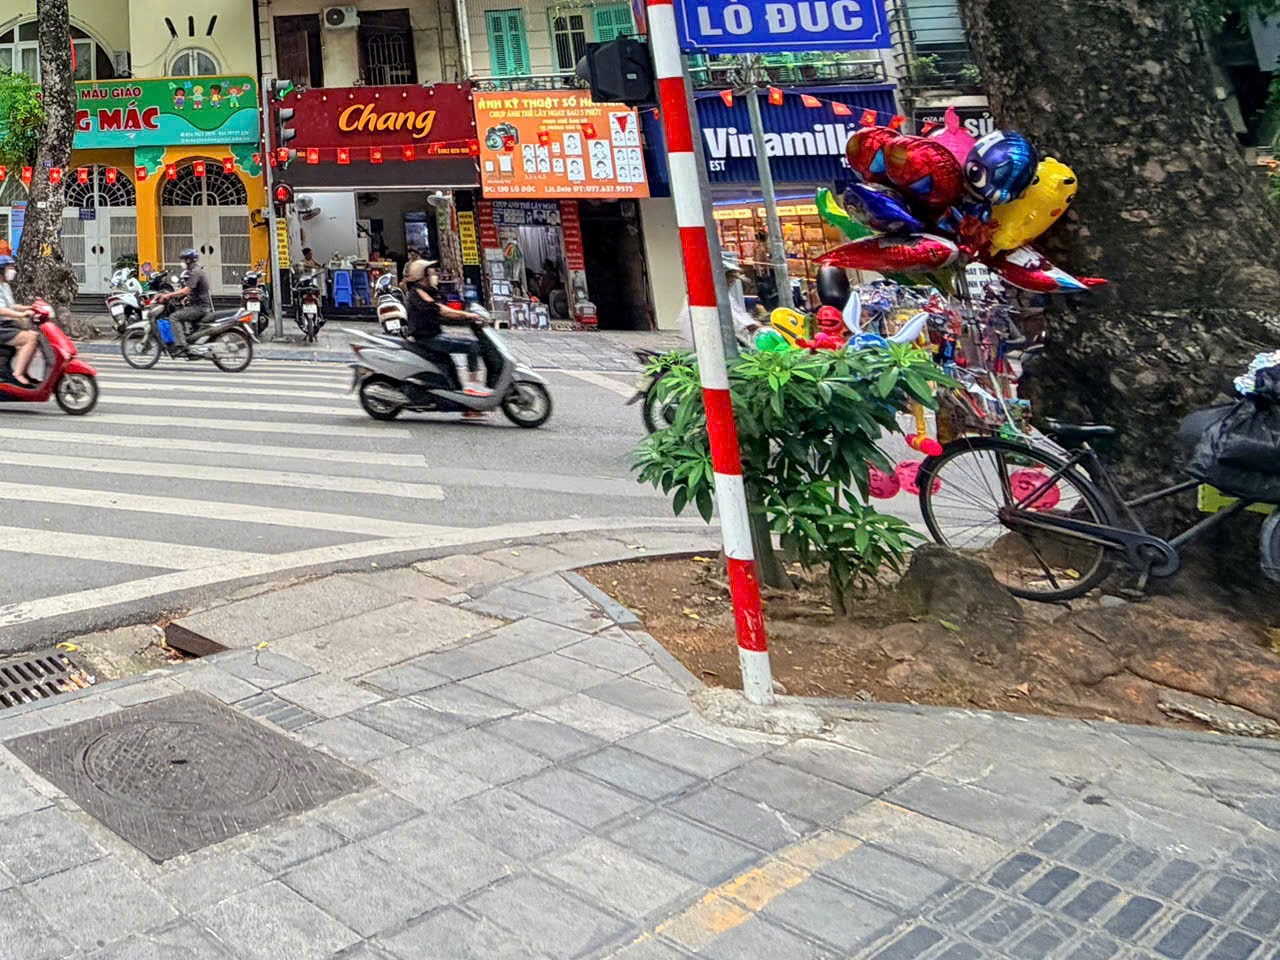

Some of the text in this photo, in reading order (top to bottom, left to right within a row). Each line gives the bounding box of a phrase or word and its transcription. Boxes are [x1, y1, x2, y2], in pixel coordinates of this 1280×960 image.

[81, 84, 142, 99] MẪU GIÁO
[562, 95, 577, 107] SỐ
[98, 100, 160, 131] MÁC
[338, 104, 436, 139] Chang
[710, 161, 725, 171] EST
